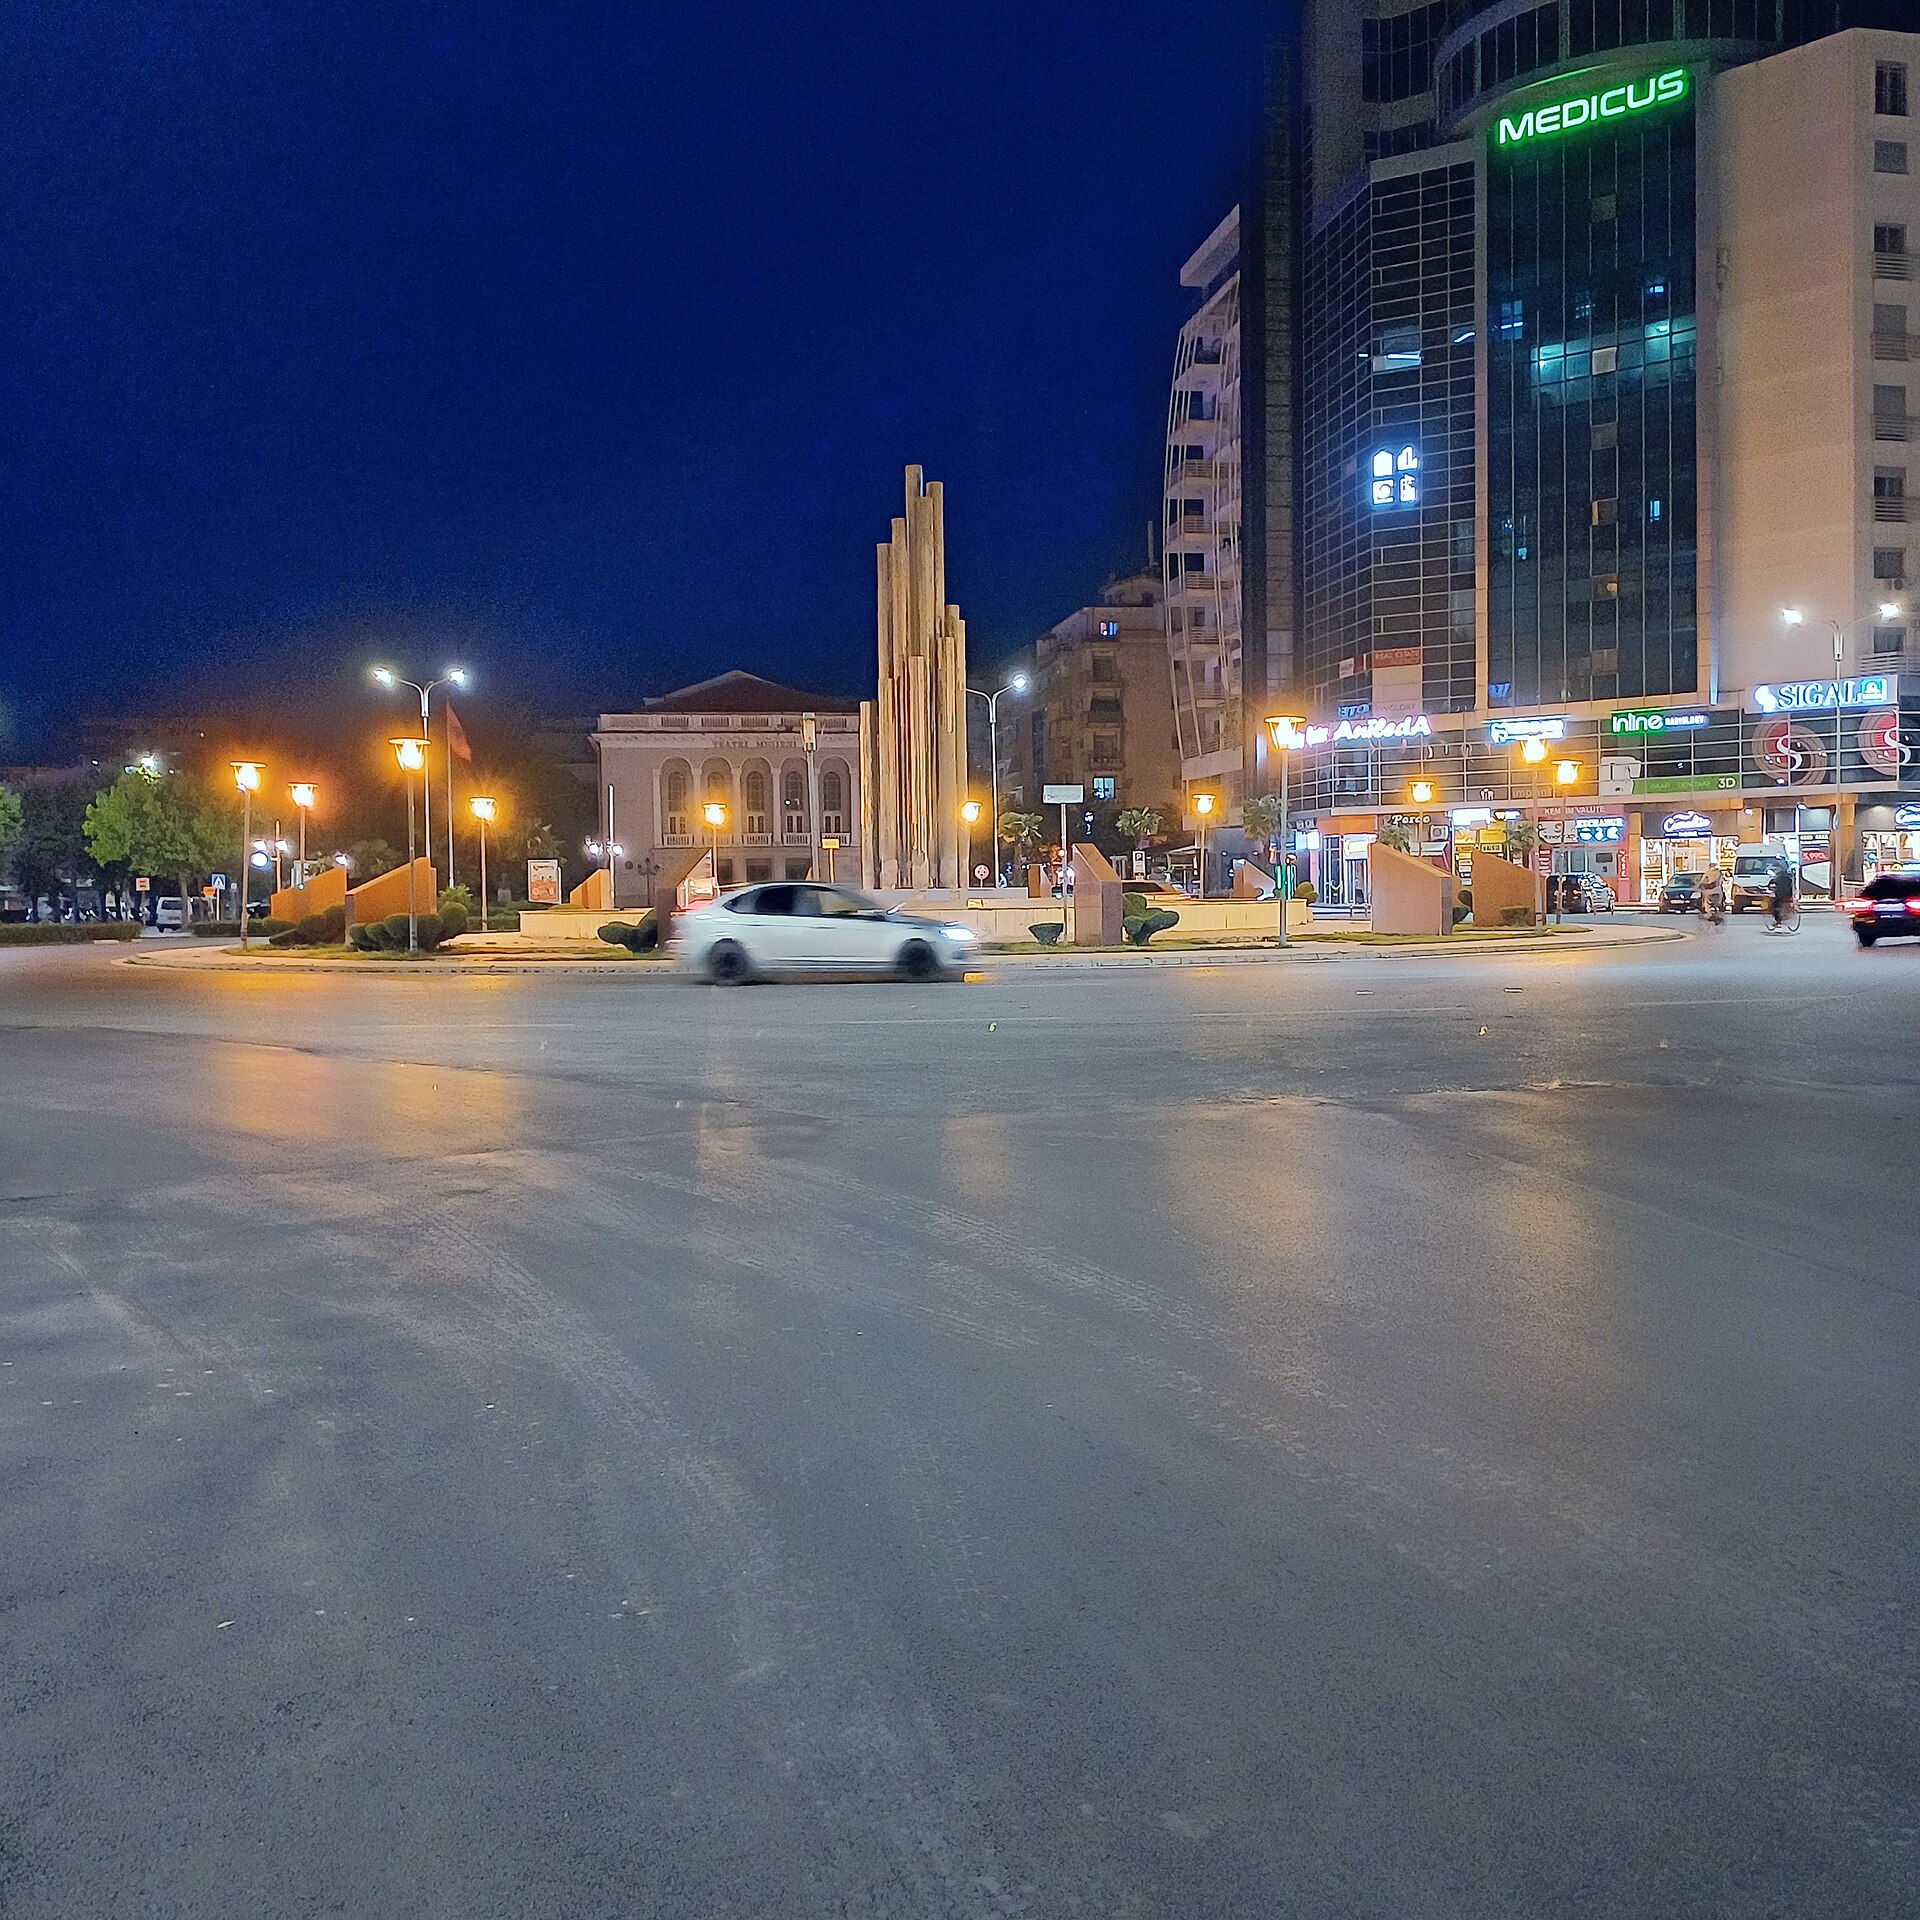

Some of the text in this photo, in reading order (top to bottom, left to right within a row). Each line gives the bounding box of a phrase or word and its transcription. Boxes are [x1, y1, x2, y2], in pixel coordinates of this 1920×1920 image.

[1499, 68, 1684, 144] MEDICUS
[1778, 680, 1862, 709] SIGAL
[1717, 777, 1736, 789] 3D
